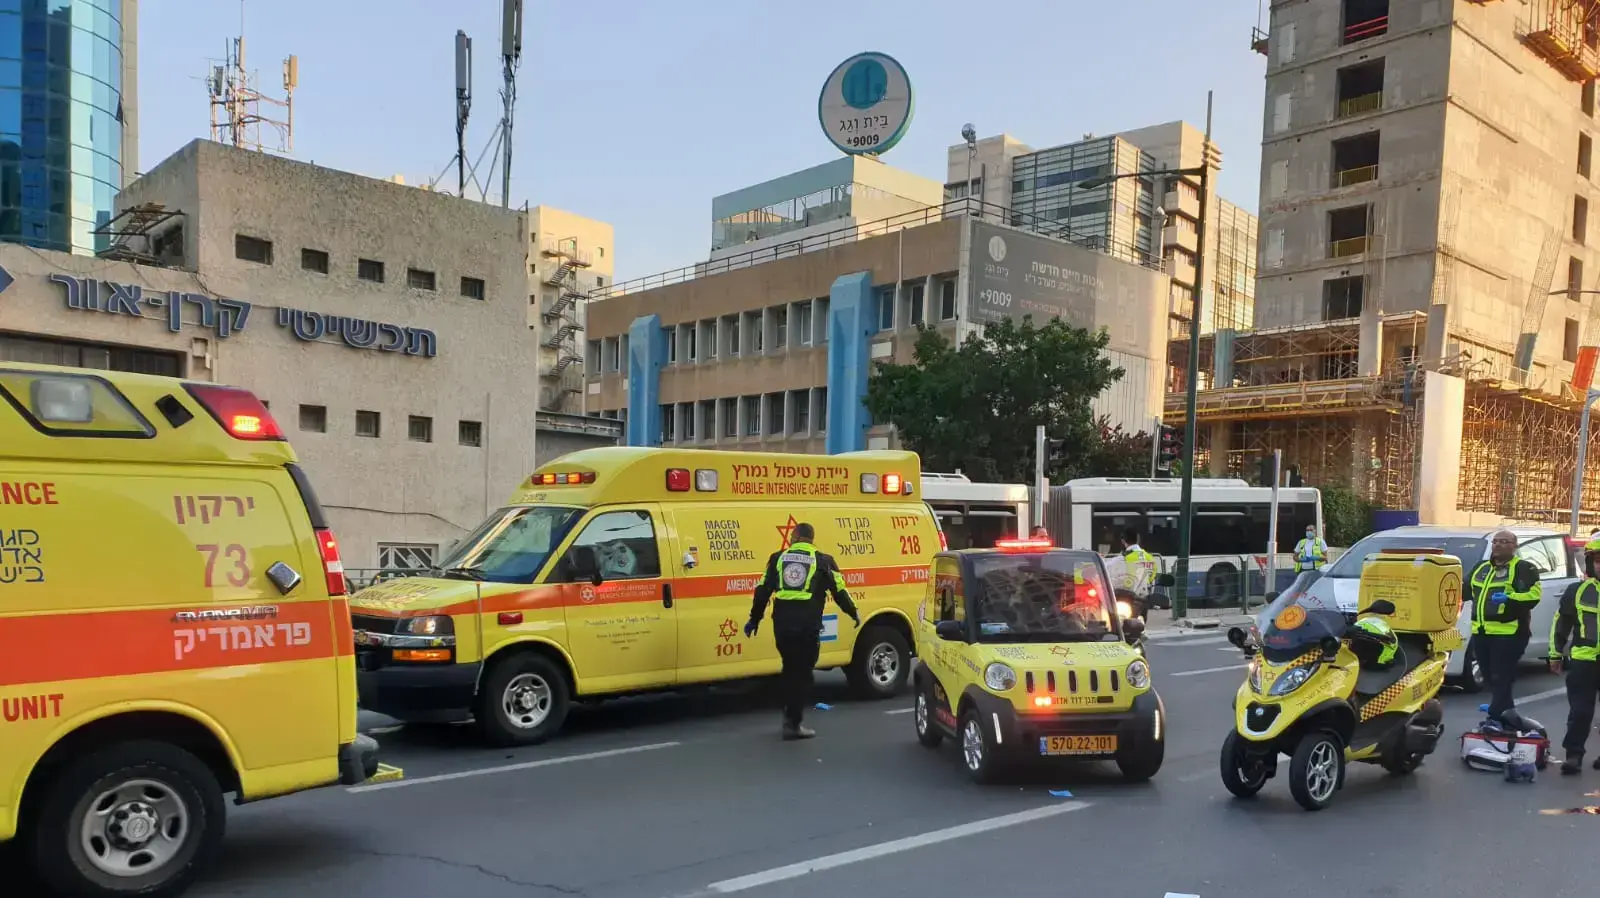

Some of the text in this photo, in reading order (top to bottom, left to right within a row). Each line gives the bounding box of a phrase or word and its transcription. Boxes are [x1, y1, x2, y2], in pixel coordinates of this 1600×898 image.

[1032, 261, 1060, 277] חדשה
[50, 273, 437, 357] תכשיטי קרן-אור
[731, 462, 849, 480] ניידת טיפול נמרץ
[0, 482, 59, 505] NCE
[731, 482, 849, 495] MOBILE INTENSIVE CARE UNIT
[173, 495, 255, 525] ירקון
[704, 519, 740, 530] MAGEN
[834, 516, 870, 530] מגן דוד
[890, 515, 919, 530] ירקון
[706, 530, 737, 540] DAVID
[849, 530, 873, 542] אדום
[709, 540, 740, 551] ADOM
[836, 542, 876, 556] בישראל
[899, 534, 921, 556] 218
[710, 550, 756, 561] IN ISRAEL
[196, 544, 250, 588] 73
[847, 573, 865, 584] ADOM
[173, 621, 312, 661] פראמדיק
[714, 642, 743, 657] 101
[3, 693, 64, 722] UNIT
[1052, 736, 1112, 751] 570-22-101
